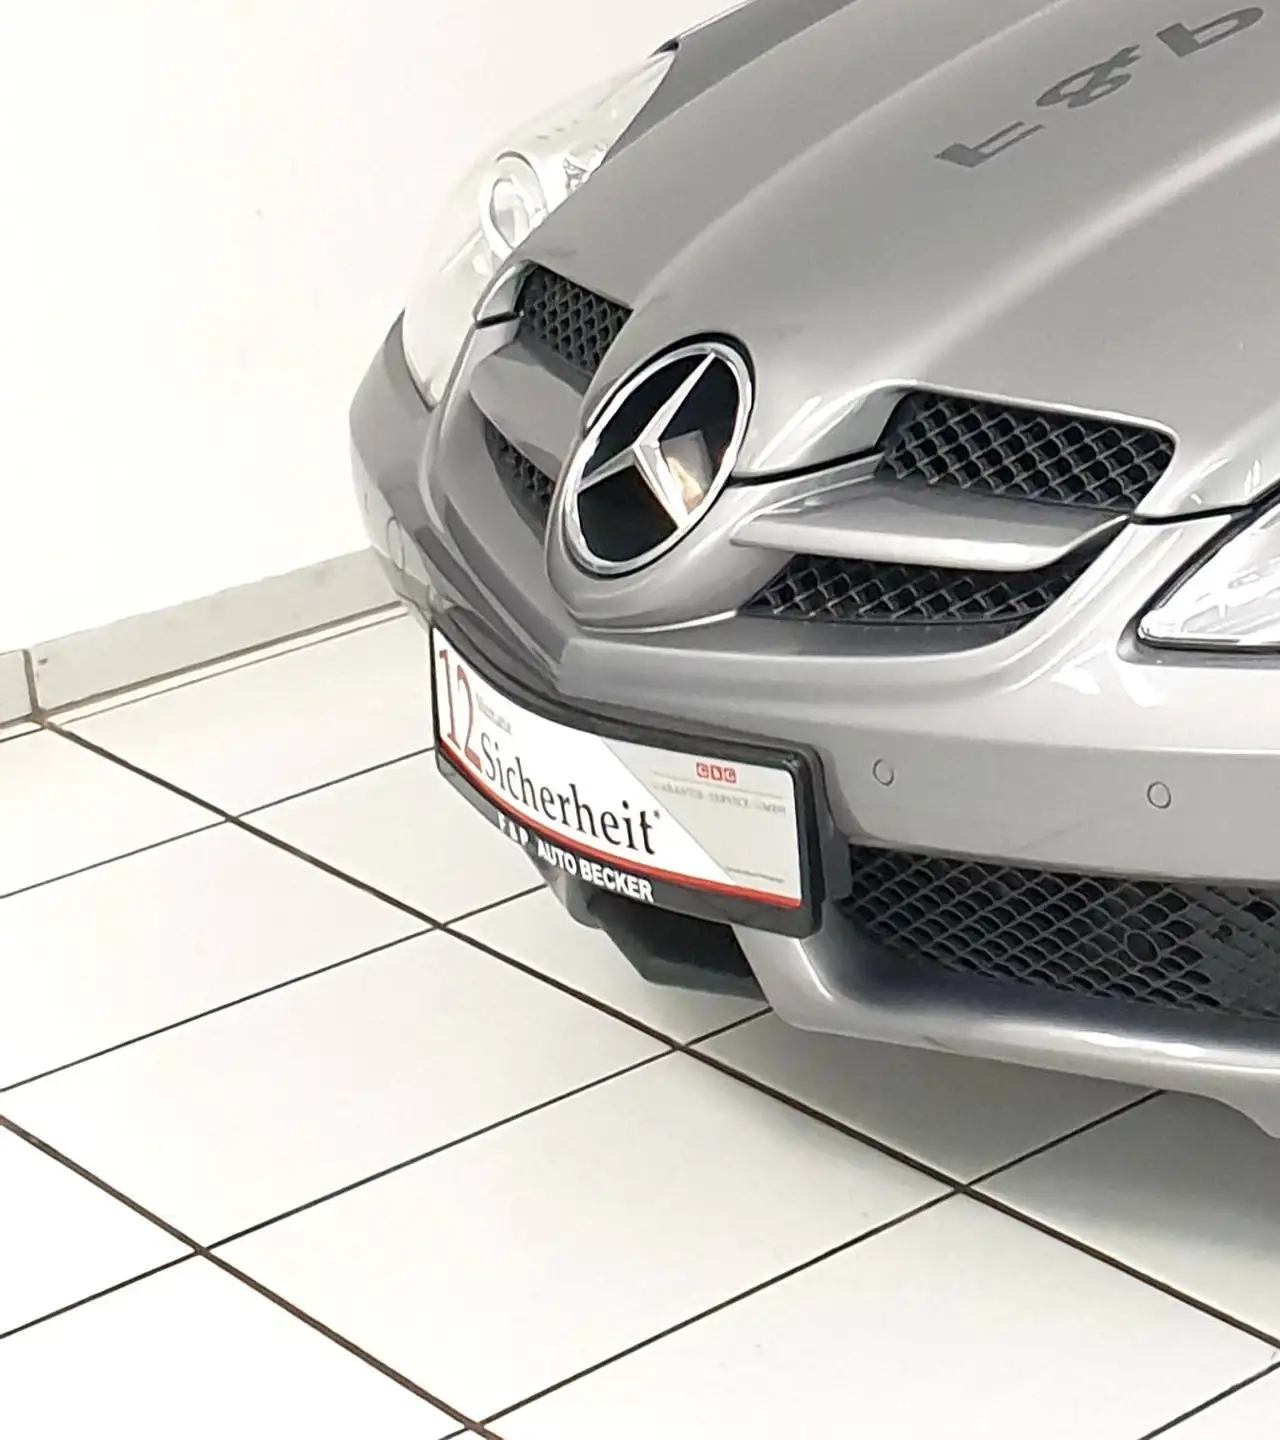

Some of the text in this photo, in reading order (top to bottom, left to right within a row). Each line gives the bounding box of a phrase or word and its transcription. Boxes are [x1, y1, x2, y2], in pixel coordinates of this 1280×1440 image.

[438, 648, 483, 773] 12
[536, 838, 578, 877] AUTO
[579, 857, 655, 904] BECKER
